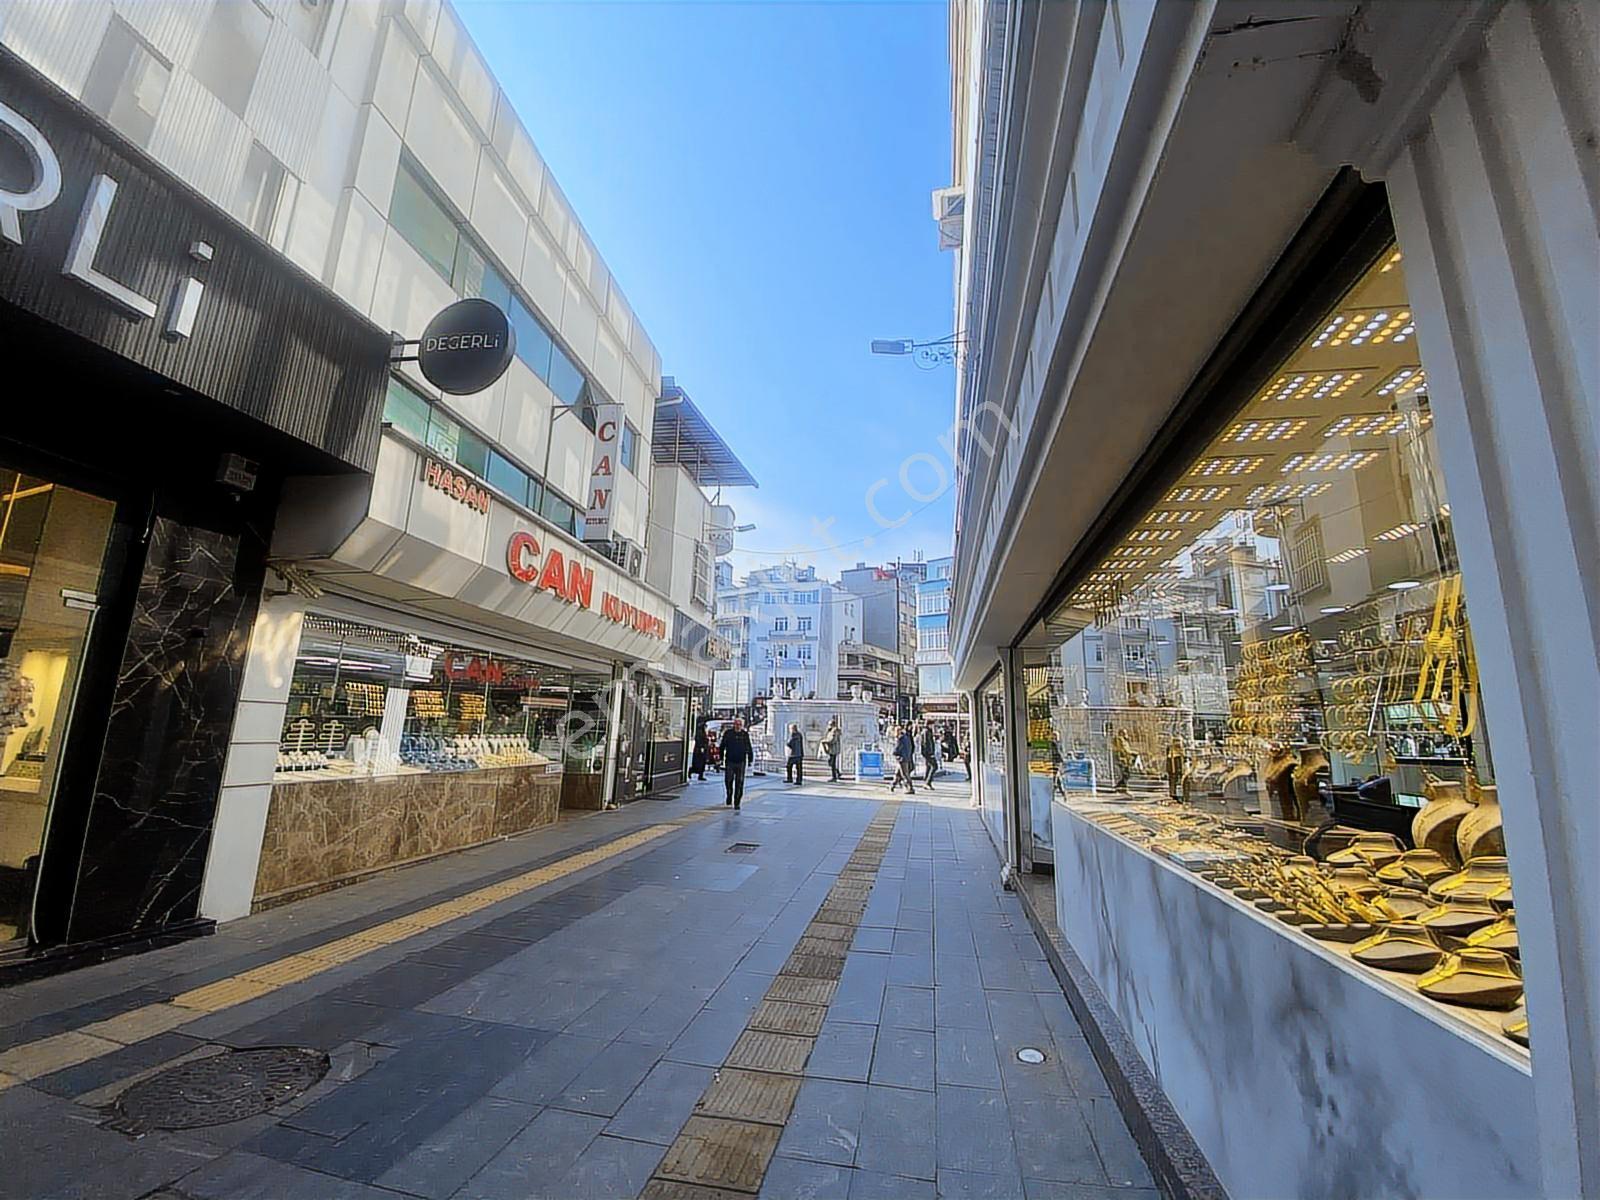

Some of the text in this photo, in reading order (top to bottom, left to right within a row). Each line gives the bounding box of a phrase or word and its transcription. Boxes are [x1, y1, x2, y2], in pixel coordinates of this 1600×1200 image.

[590, 421, 617, 510] CAN
[424, 456, 491, 515] HASAN
[507, 531, 594, 609] CAN
